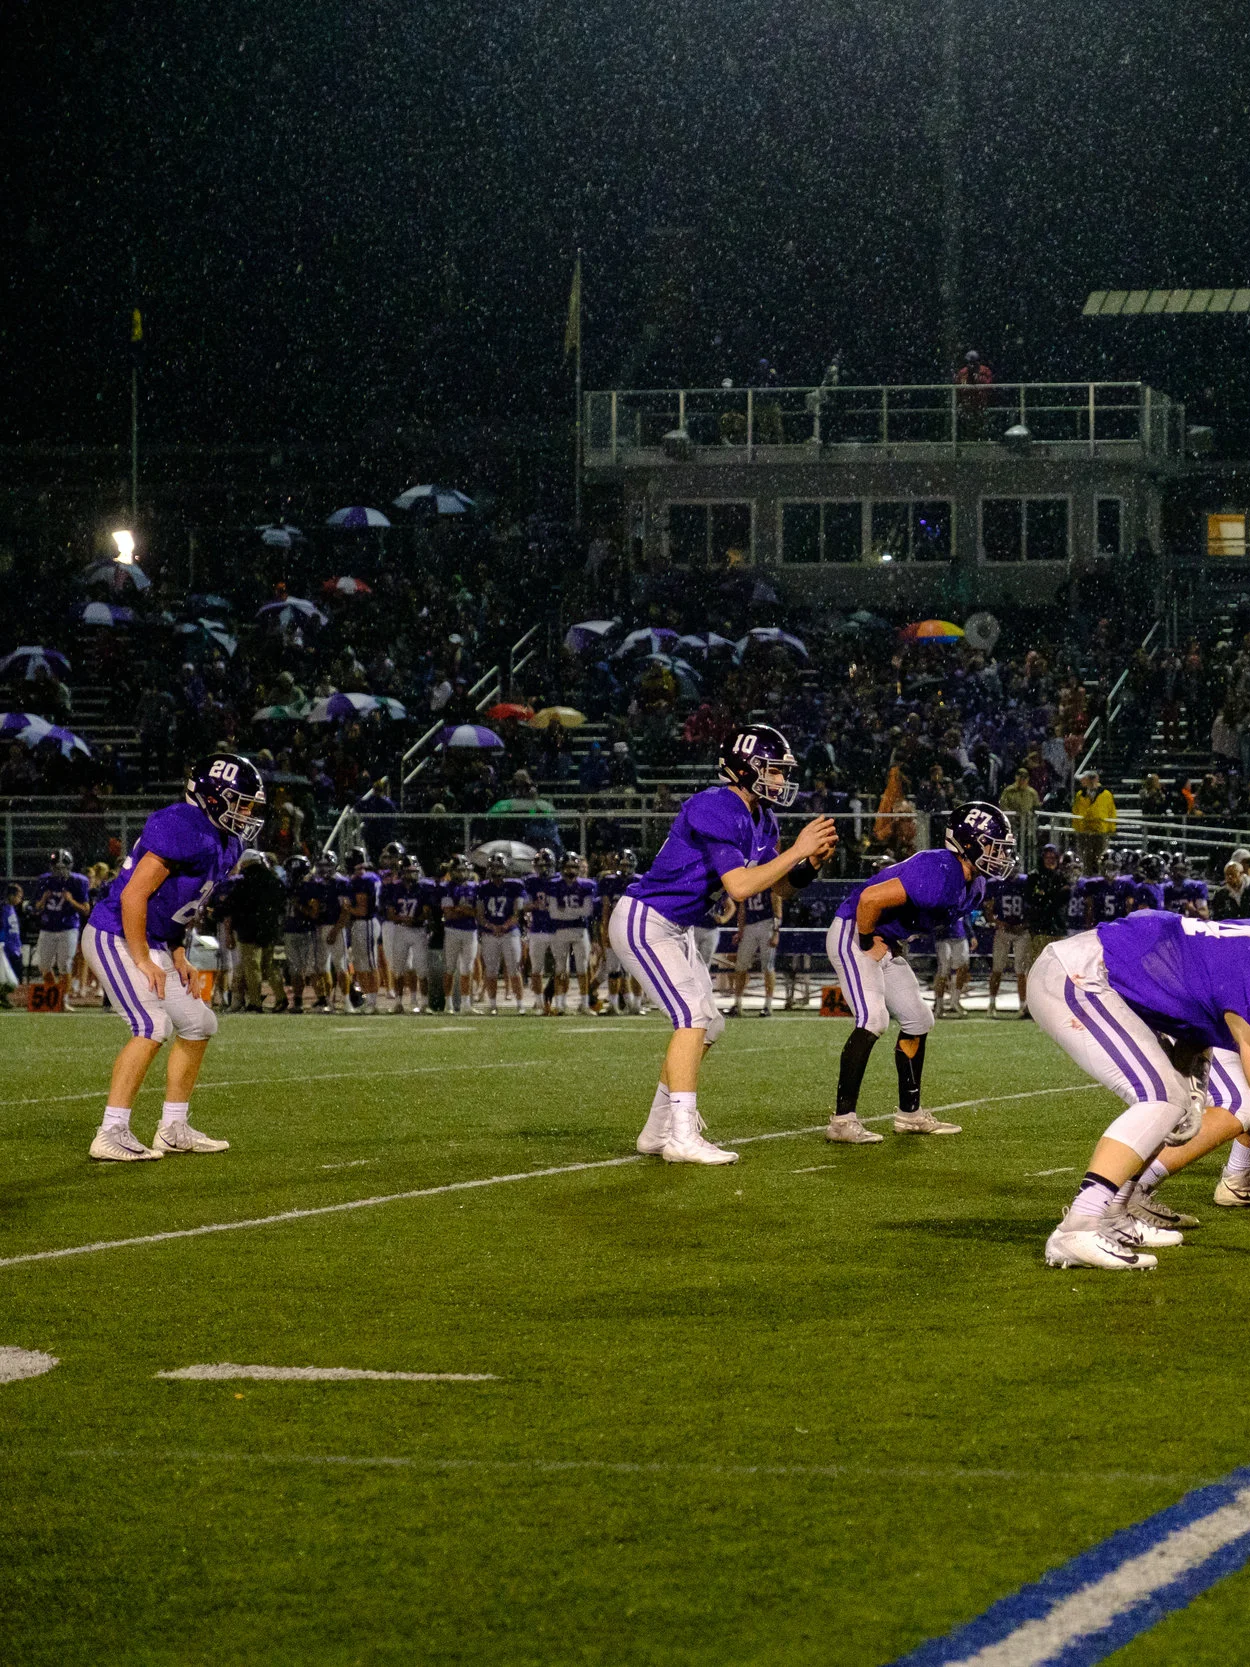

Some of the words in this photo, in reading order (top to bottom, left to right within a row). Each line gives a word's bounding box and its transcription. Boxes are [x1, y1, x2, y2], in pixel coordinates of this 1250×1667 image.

[732, 733, 758, 754] 10
[208, 760, 240, 782] 20
[964, 808, 993, 831] 27
[397, 897, 418, 918] 37
[1002, 895, 1022, 917] 58
[1104, 894, 1116, 916] 5
[32, 985, 59, 1009] 50
